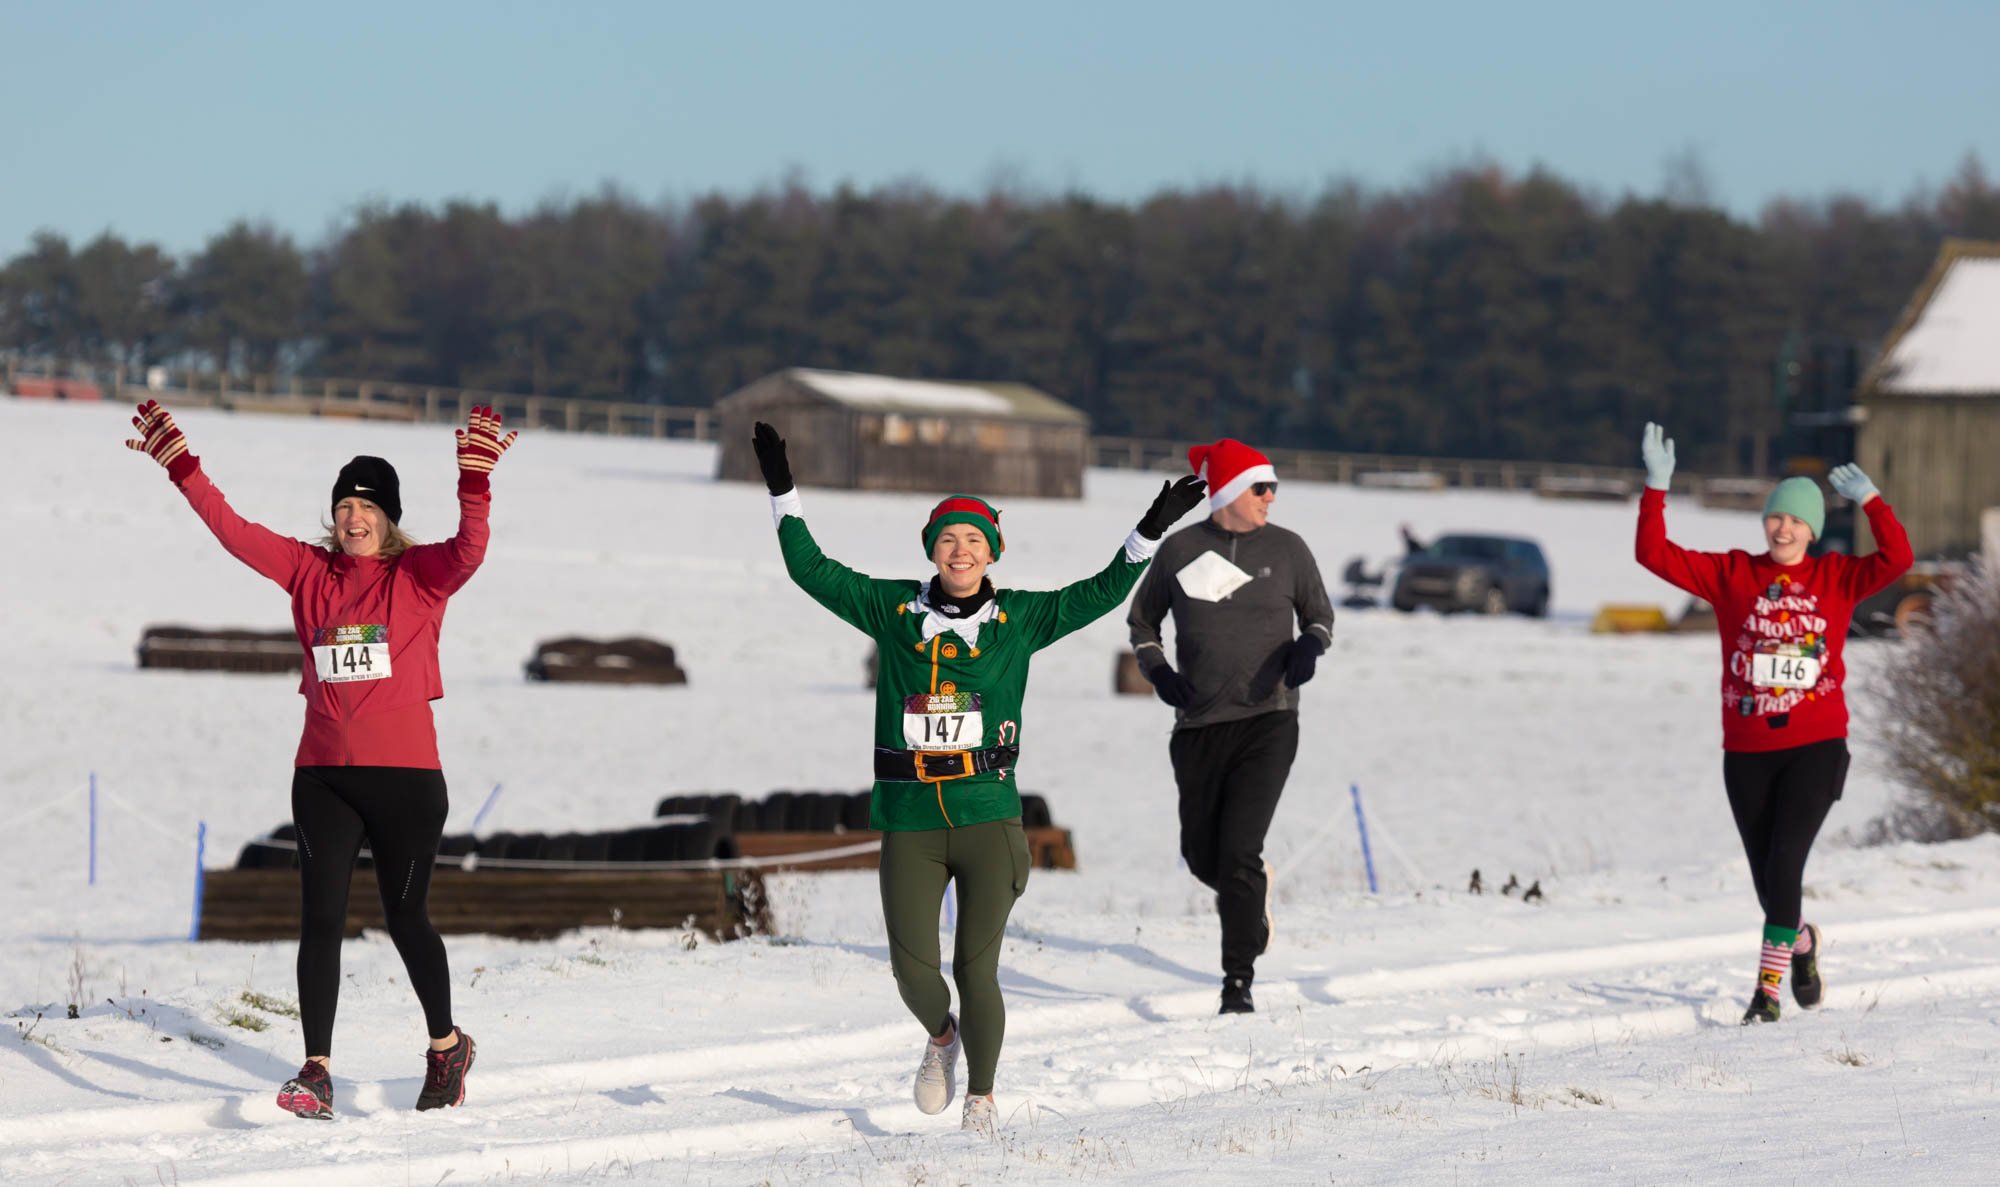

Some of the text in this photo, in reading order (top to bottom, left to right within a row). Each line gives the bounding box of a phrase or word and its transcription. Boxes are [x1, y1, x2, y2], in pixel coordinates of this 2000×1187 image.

[1743, 614, 1827, 637] AROUND
[331, 646, 372, 674] 144
[1771, 658, 1805, 680] 146
[941, 695, 954, 703] ZAG
[1755, 690, 1805, 716] TREE
[924, 715, 965, 743] 147
